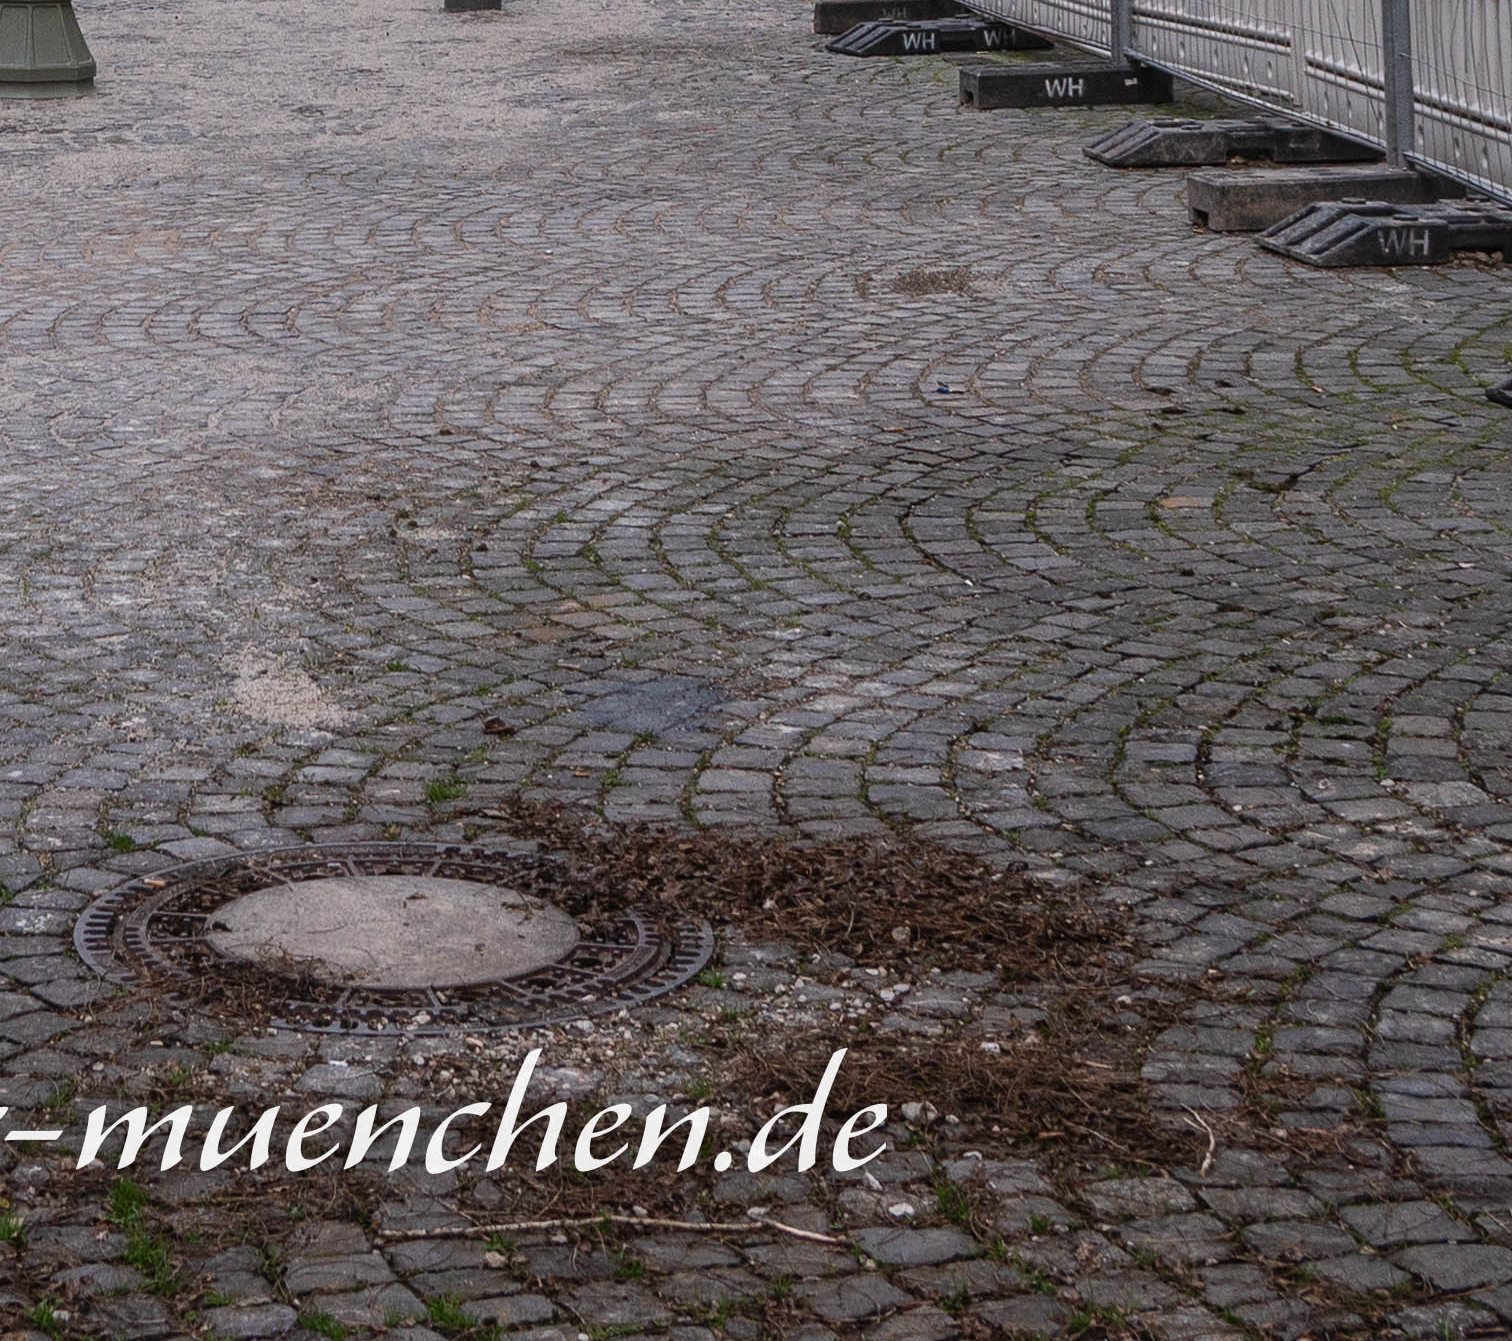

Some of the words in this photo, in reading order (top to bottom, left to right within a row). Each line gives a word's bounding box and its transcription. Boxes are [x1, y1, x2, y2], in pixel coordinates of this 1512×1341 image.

[903, 32, 936, 51] WH
[983, 29, 1016, 47] WH
[1045, 77, 1084, 98] WH
[1377, 228, 1430, 256] WH
